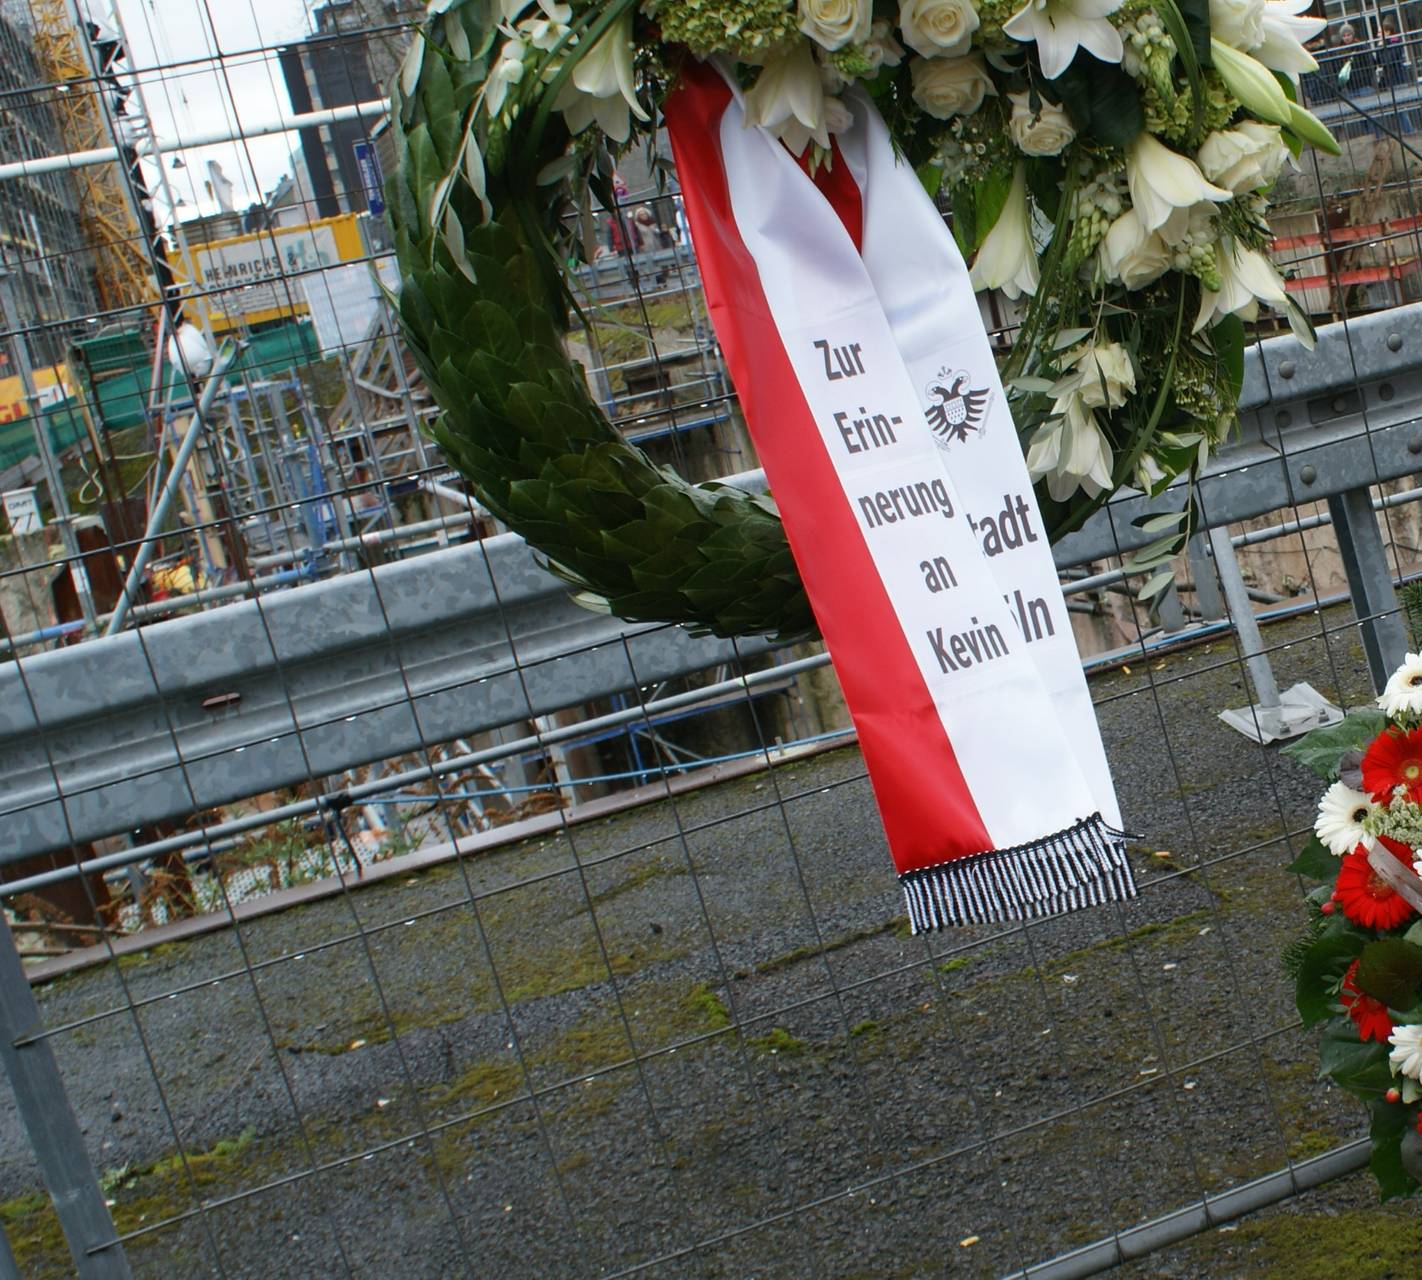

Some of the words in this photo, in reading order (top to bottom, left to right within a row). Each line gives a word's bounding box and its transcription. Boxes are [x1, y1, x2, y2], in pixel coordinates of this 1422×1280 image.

[813, 338, 866, 381] Zur
[833, 406, 903, 454] Erin-
[857, 478, 955, 528] nerung
[919, 555, 958, 594] an
[926, 616, 1010, 674] Kevin
